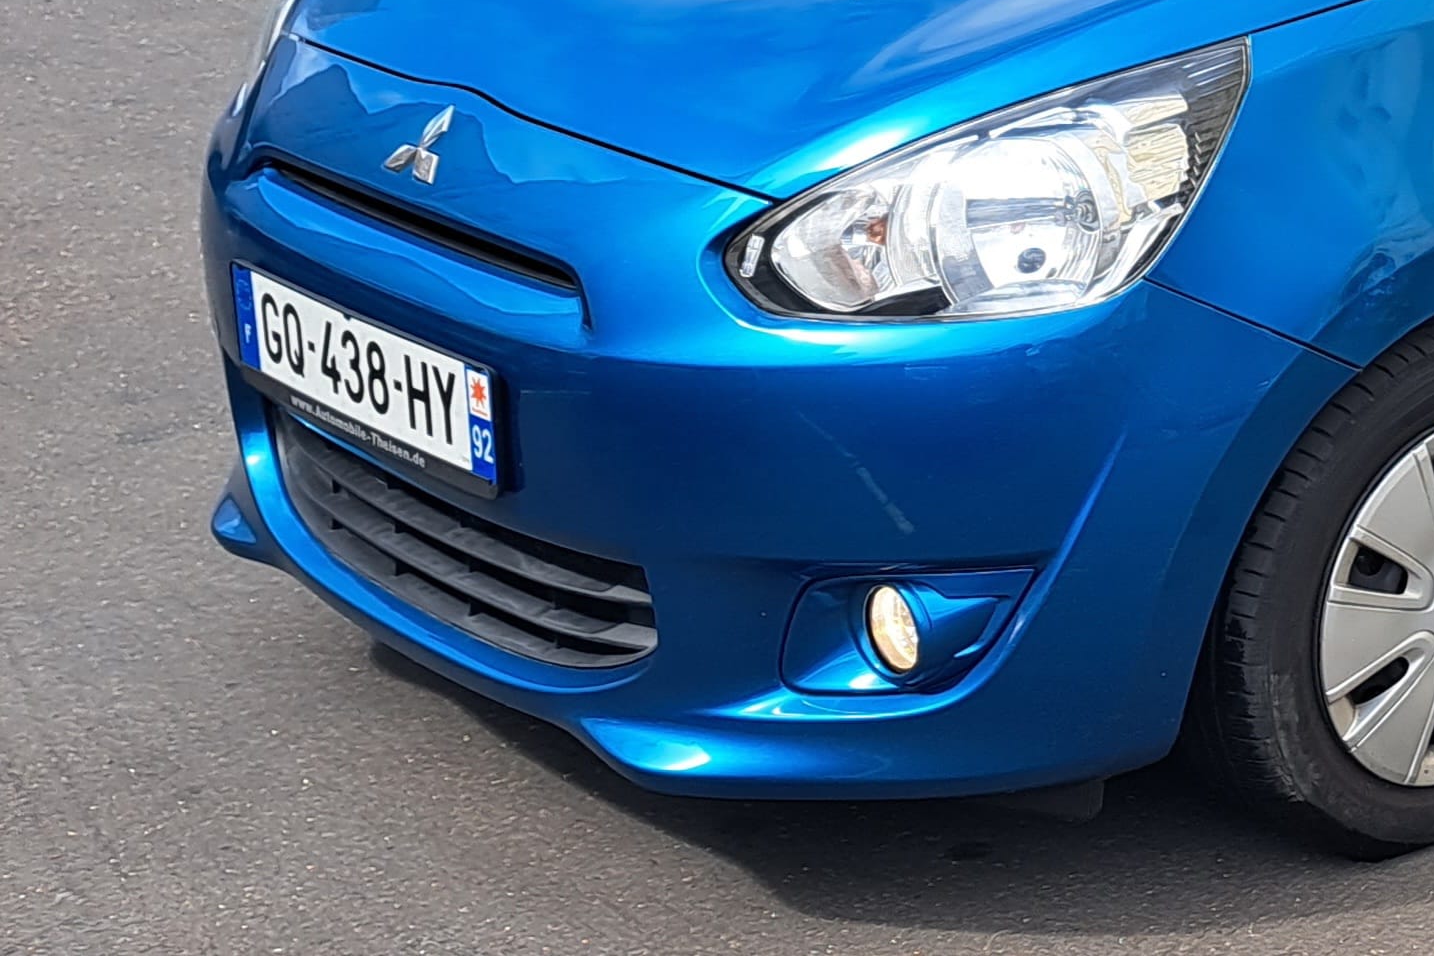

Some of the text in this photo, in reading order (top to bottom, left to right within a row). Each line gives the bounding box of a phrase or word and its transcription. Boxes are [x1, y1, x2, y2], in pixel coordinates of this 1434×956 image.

[245, 323, 251, 343] F
[261, 292, 455, 445] GQ-438-HY
[290, 395, 426, 468] www.Automobile-Theisen.de
[472, 424, 495, 464] 92
